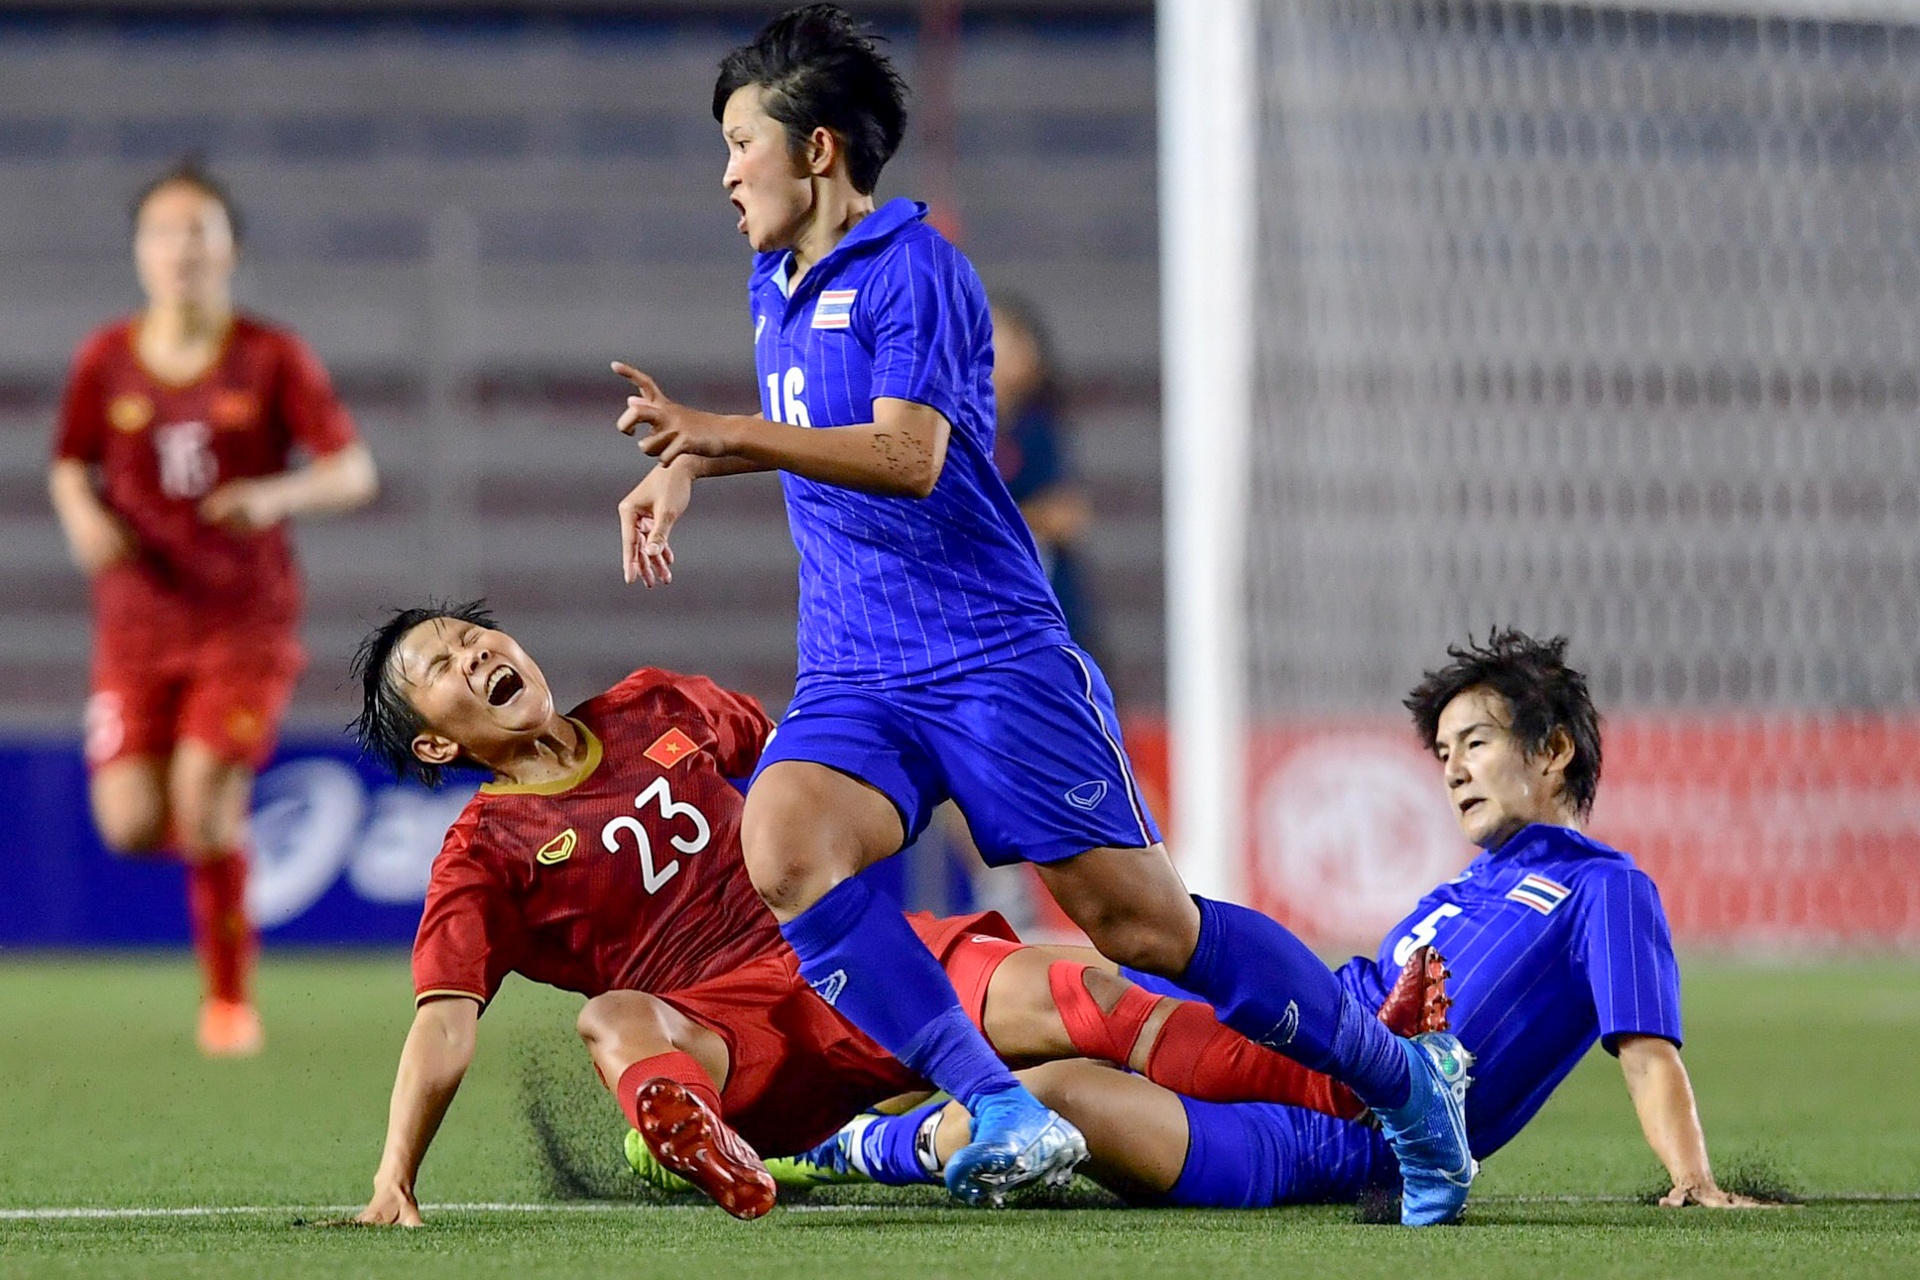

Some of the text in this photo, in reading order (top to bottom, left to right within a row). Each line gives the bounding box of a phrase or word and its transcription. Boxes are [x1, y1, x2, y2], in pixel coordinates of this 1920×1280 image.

[767, 367, 811, 428] 16
[602, 776, 711, 894] 23
[1393, 902, 1463, 967] 5
